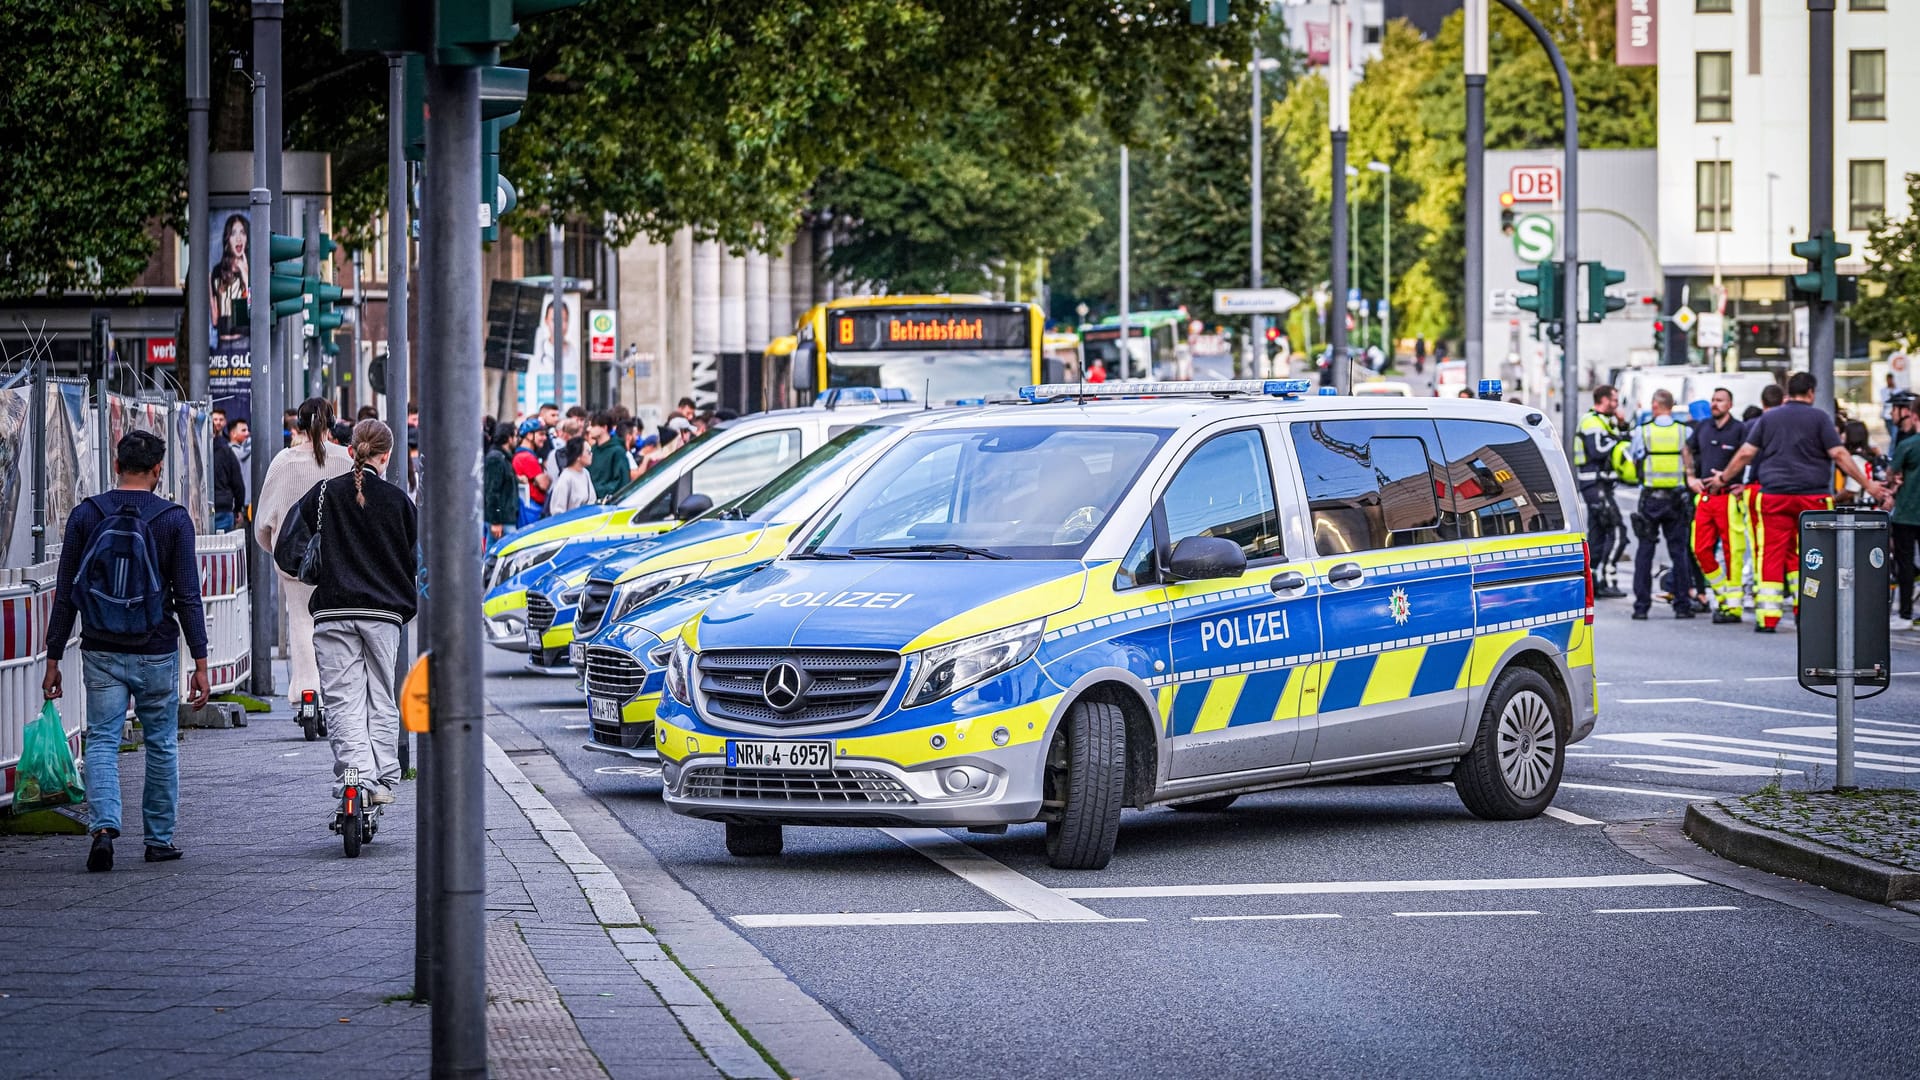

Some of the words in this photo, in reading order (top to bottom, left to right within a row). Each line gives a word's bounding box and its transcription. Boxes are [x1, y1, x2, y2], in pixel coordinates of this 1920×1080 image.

[1517, 173, 1553, 195] DB
[1516, 215, 1553, 261] S
[889, 318, 983, 341] Betriebsfahrt
[753, 591, 916, 609] POLIZEI
[1200, 609, 1290, 652] POLIZEI
[736, 744, 763, 765] NRW
[772, 745, 829, 766] 4-6957
